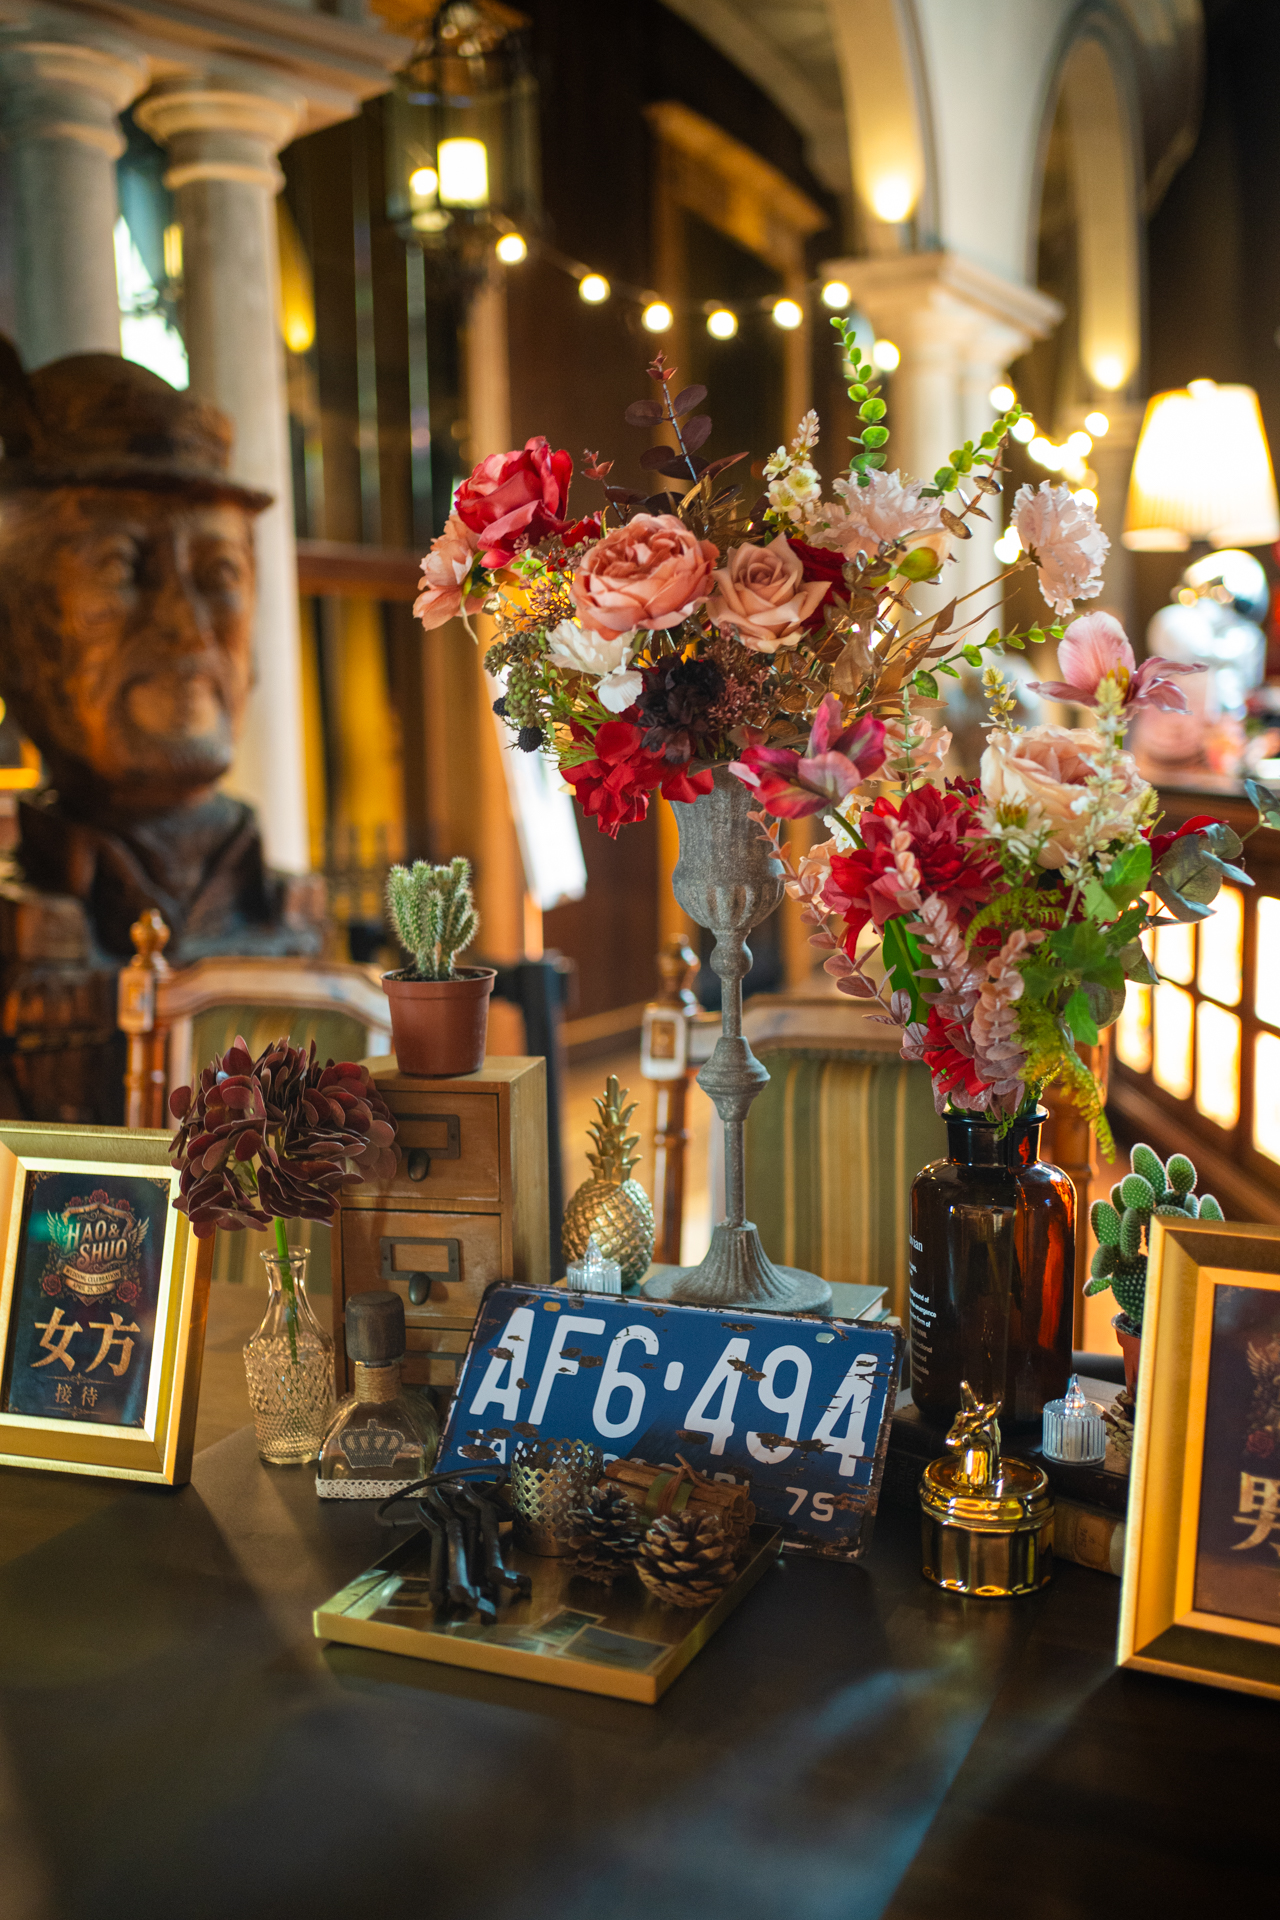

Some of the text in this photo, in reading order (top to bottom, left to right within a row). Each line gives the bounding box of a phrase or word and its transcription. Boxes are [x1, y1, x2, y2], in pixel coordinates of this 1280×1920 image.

[77, 1238, 128, 1269] SHUO
[65, 1267, 120, 1283] WEDDING CELEBRATION
[73, 1283, 86, 1293] APRIL
[30, 1306, 141, 1377] 女方
